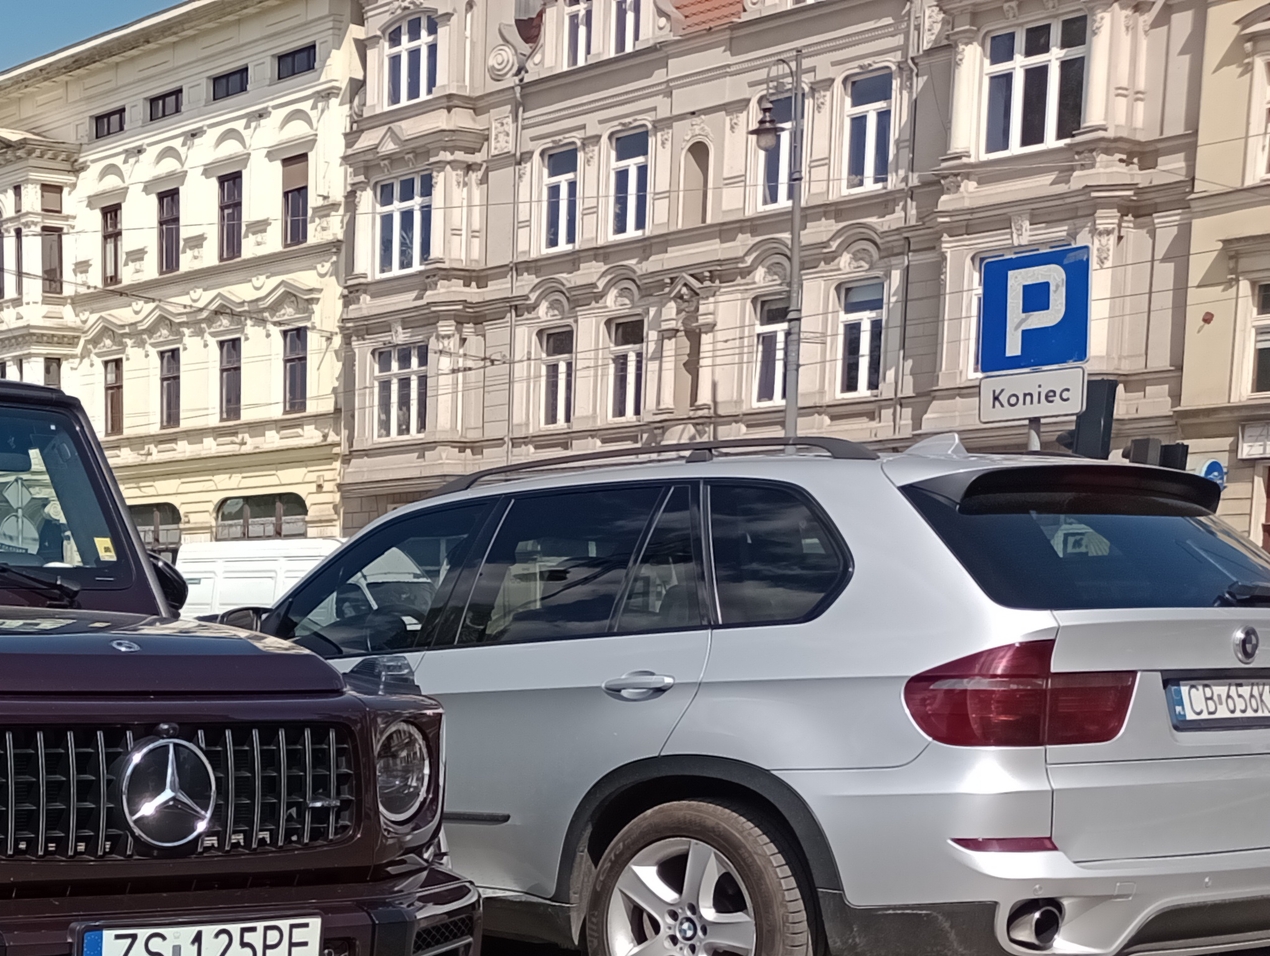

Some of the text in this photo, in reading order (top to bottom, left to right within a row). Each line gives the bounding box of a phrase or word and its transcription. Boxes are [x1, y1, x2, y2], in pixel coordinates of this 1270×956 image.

[1005, 263, 1067, 357] P
[991, 384, 1071, 409] Koniec
[1187, 683, 1219, 716] CB
